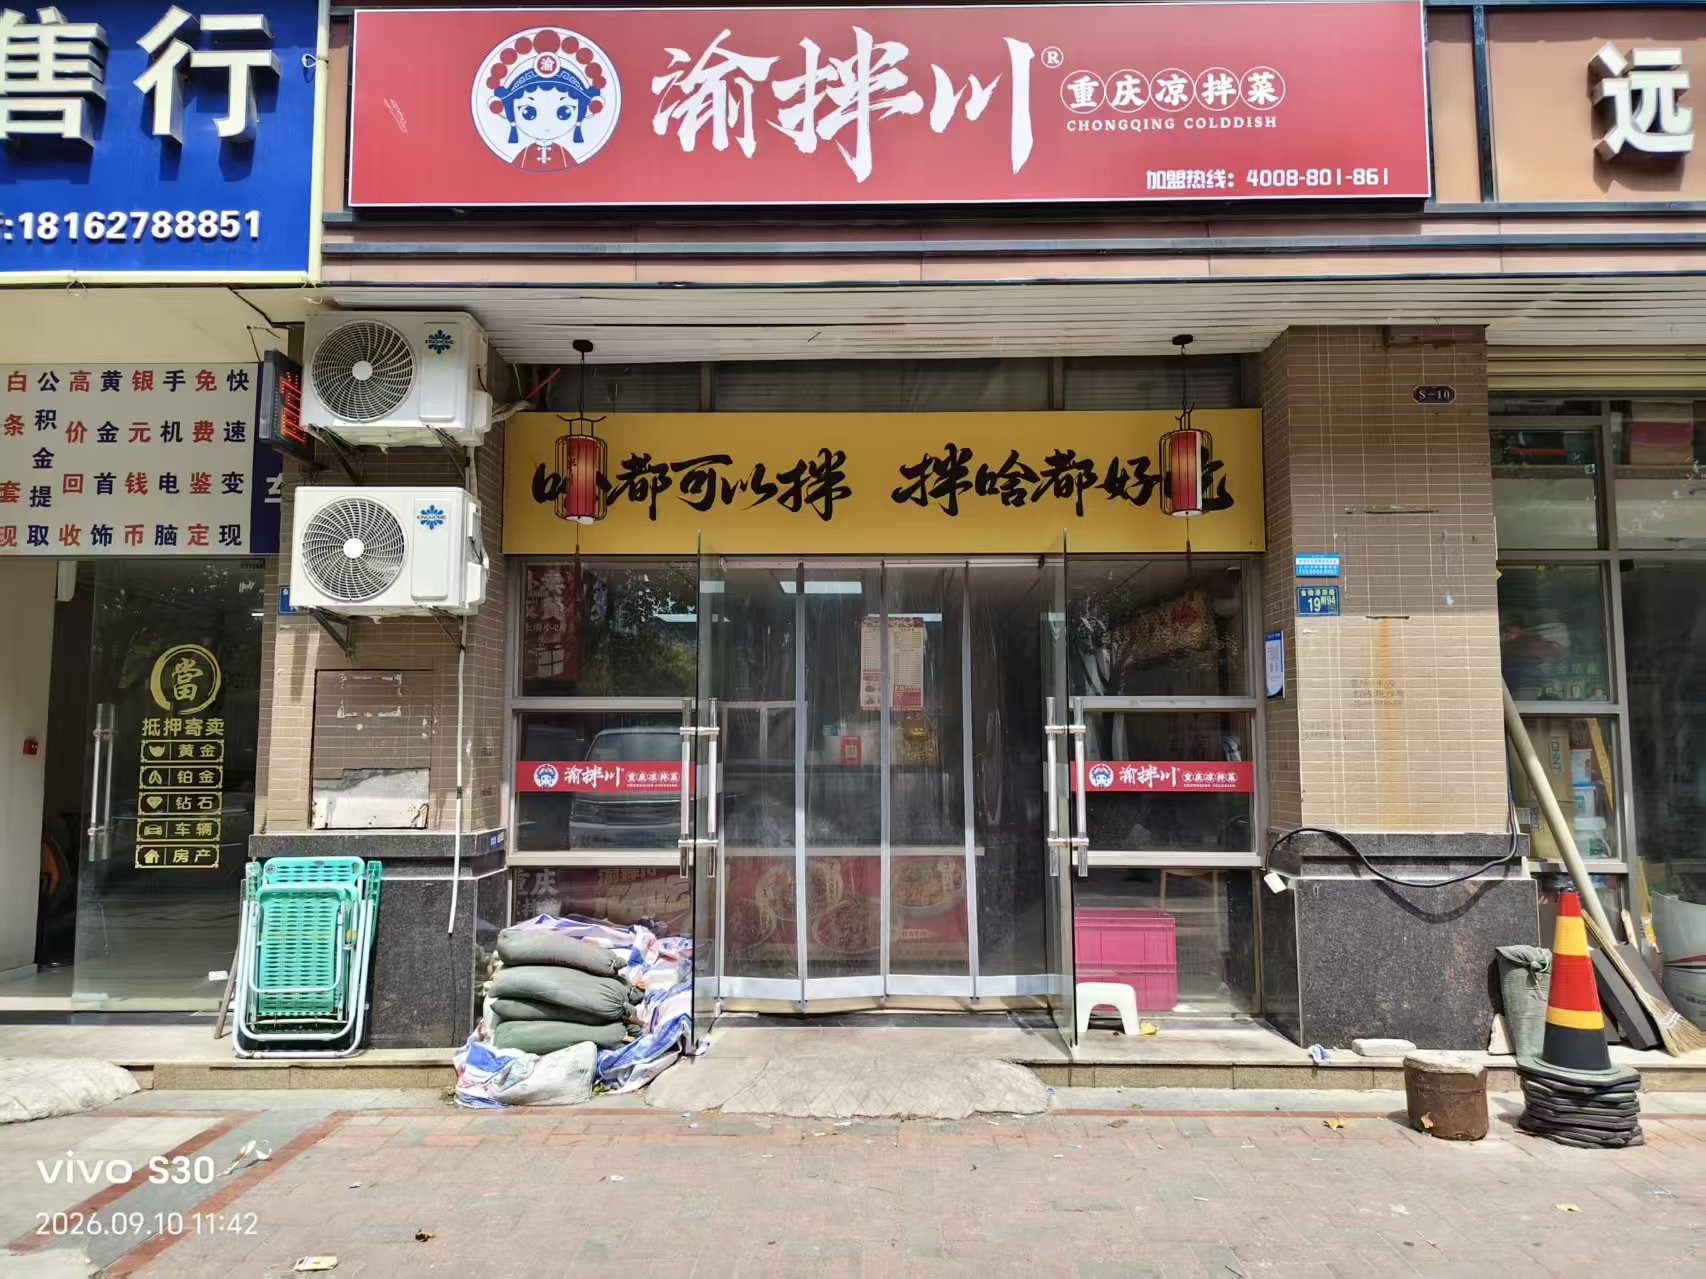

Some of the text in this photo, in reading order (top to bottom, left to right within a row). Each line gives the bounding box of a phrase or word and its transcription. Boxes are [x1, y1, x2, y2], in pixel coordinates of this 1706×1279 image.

[0, 4, 280, 147] 售行
[1066, 71, 1280, 109] 重庆凉拌菜
[1588, 41, 1695, 156] 远
[652, 25, 1036, 184] 渝拌川
[1066, 115, 1278, 133] CHONGQING COLDDISH
[1246, 168, 1389, 188] 4008-801-861
[0, 210, 260, 240] :18162788851
[141, 717, 225, 738] 抵押寄卖
[177, 743, 216, 759] 黄金
[176, 769, 216, 784] 铂金
[564, 764, 621, 788] 渝拌川
[1118, 763, 1177, 788] 渝拌川
[175, 795, 214, 810] 钻石
[174, 822, 213, 837] 车辆
[172, 848, 212, 864] 房产
